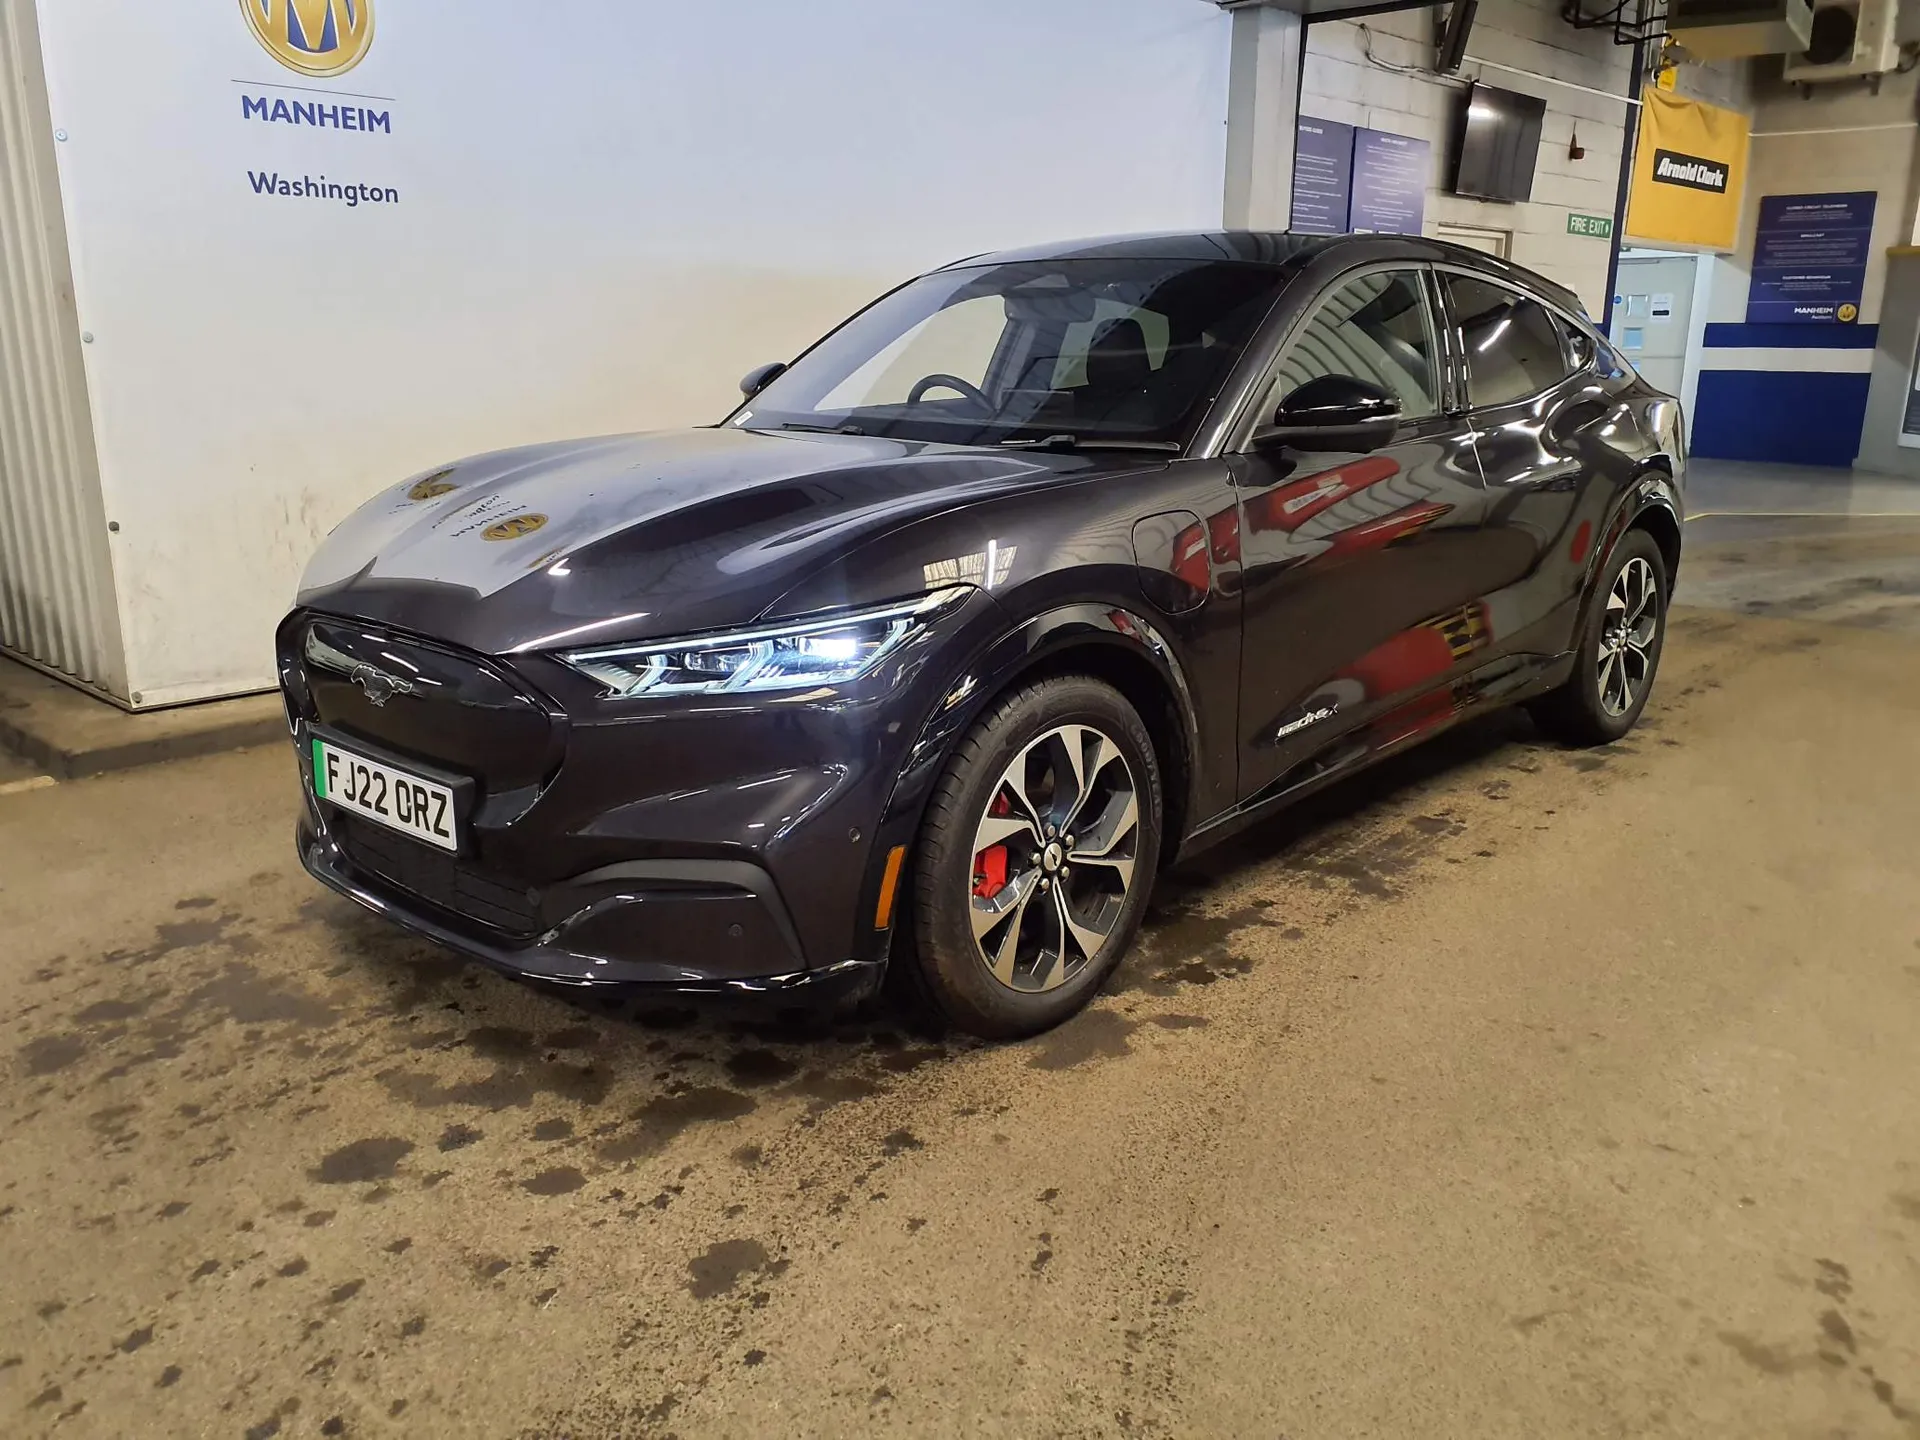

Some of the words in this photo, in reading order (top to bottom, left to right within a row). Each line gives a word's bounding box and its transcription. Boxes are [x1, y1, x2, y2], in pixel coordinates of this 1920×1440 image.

[242, 95, 391, 134] MANHEIM
[247, 170, 399, 207] Washington
[1657, 157, 1698, 182] Arnold
[1696, 165, 1724, 187] Clark
[1570, 217, 1587, 232] FIRE
[1589, 219, 1606, 235] EXIT
[1794, 306, 1834, 314] MANHEIM
[326, 752, 389, 817] FJ22
[395, 778, 450, 839] ORZ
